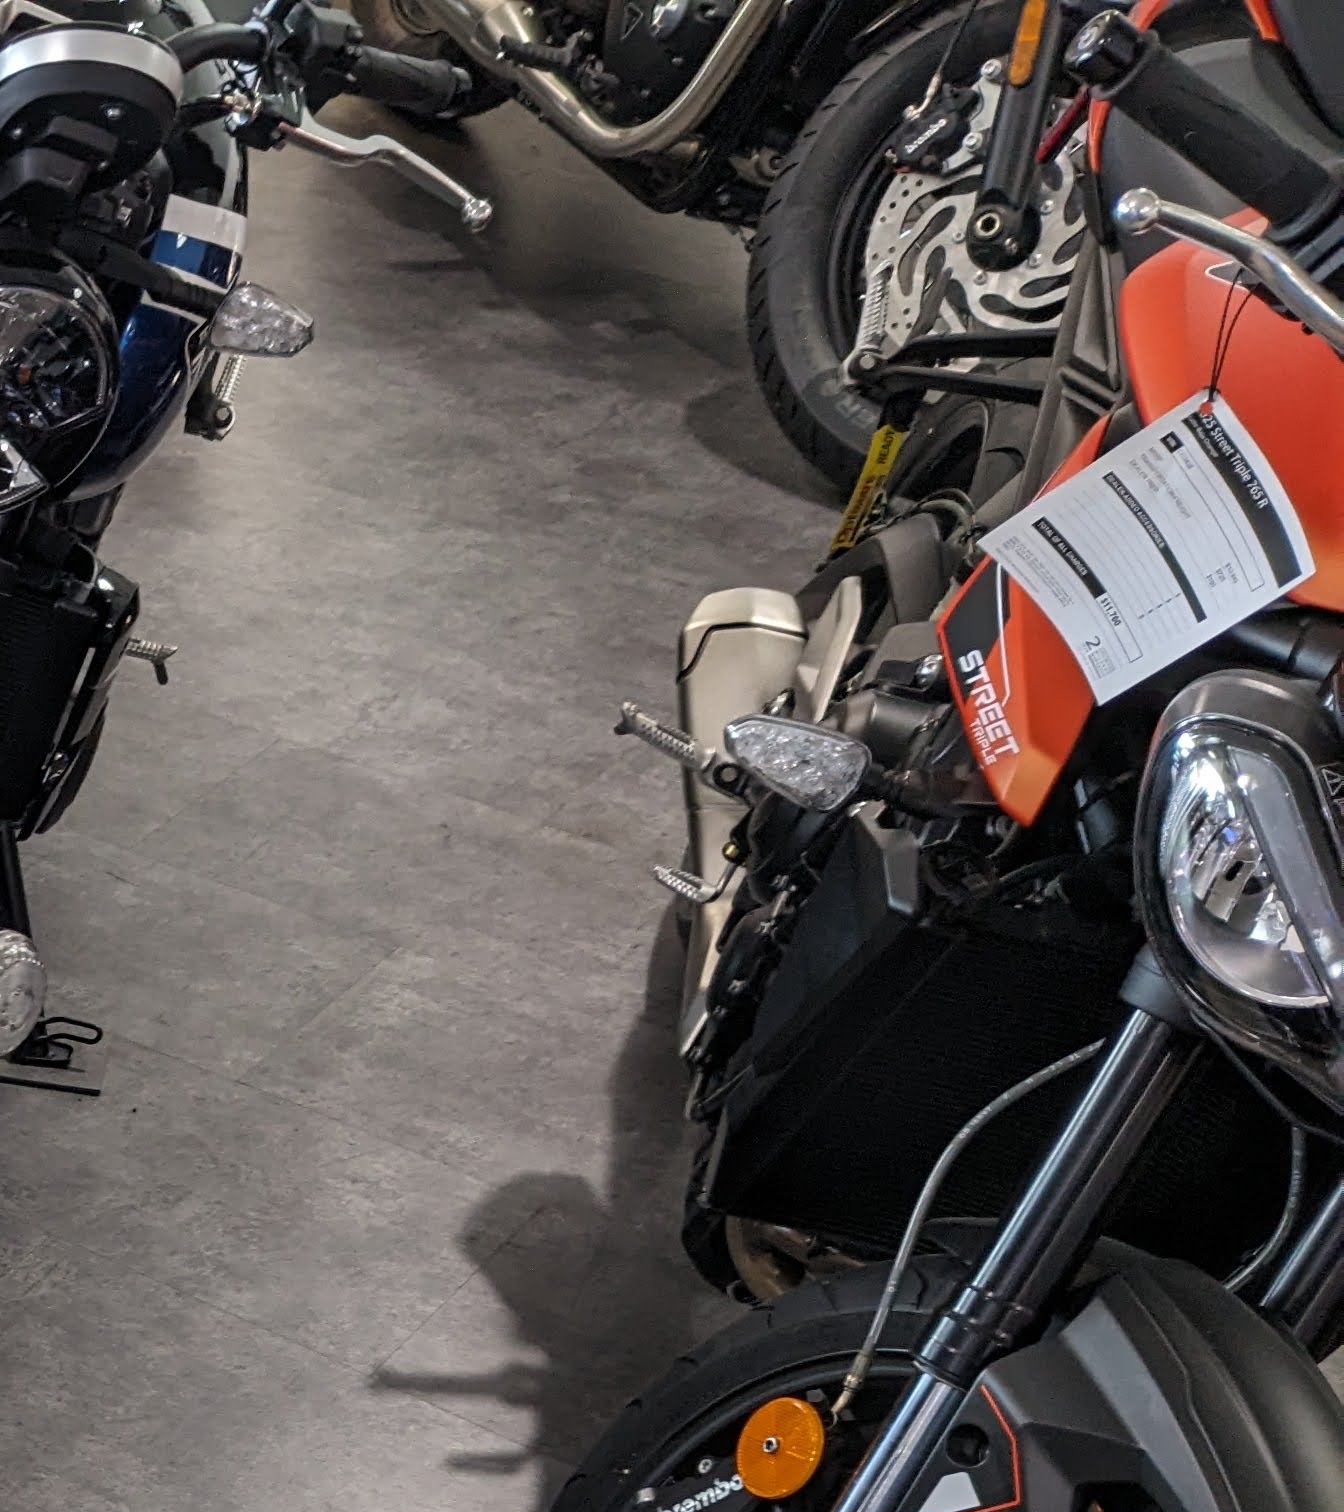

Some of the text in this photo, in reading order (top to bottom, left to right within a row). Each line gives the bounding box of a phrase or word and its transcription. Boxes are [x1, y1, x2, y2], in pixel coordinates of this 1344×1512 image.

[1211, 426, 1235, 458] Street
[1230, 454, 1252, 482] Triple
[1247, 479, 1263, 504] 765
[957, 649, 1021, 755] STREET
[969, 717, 998, 766] TRIPLE
